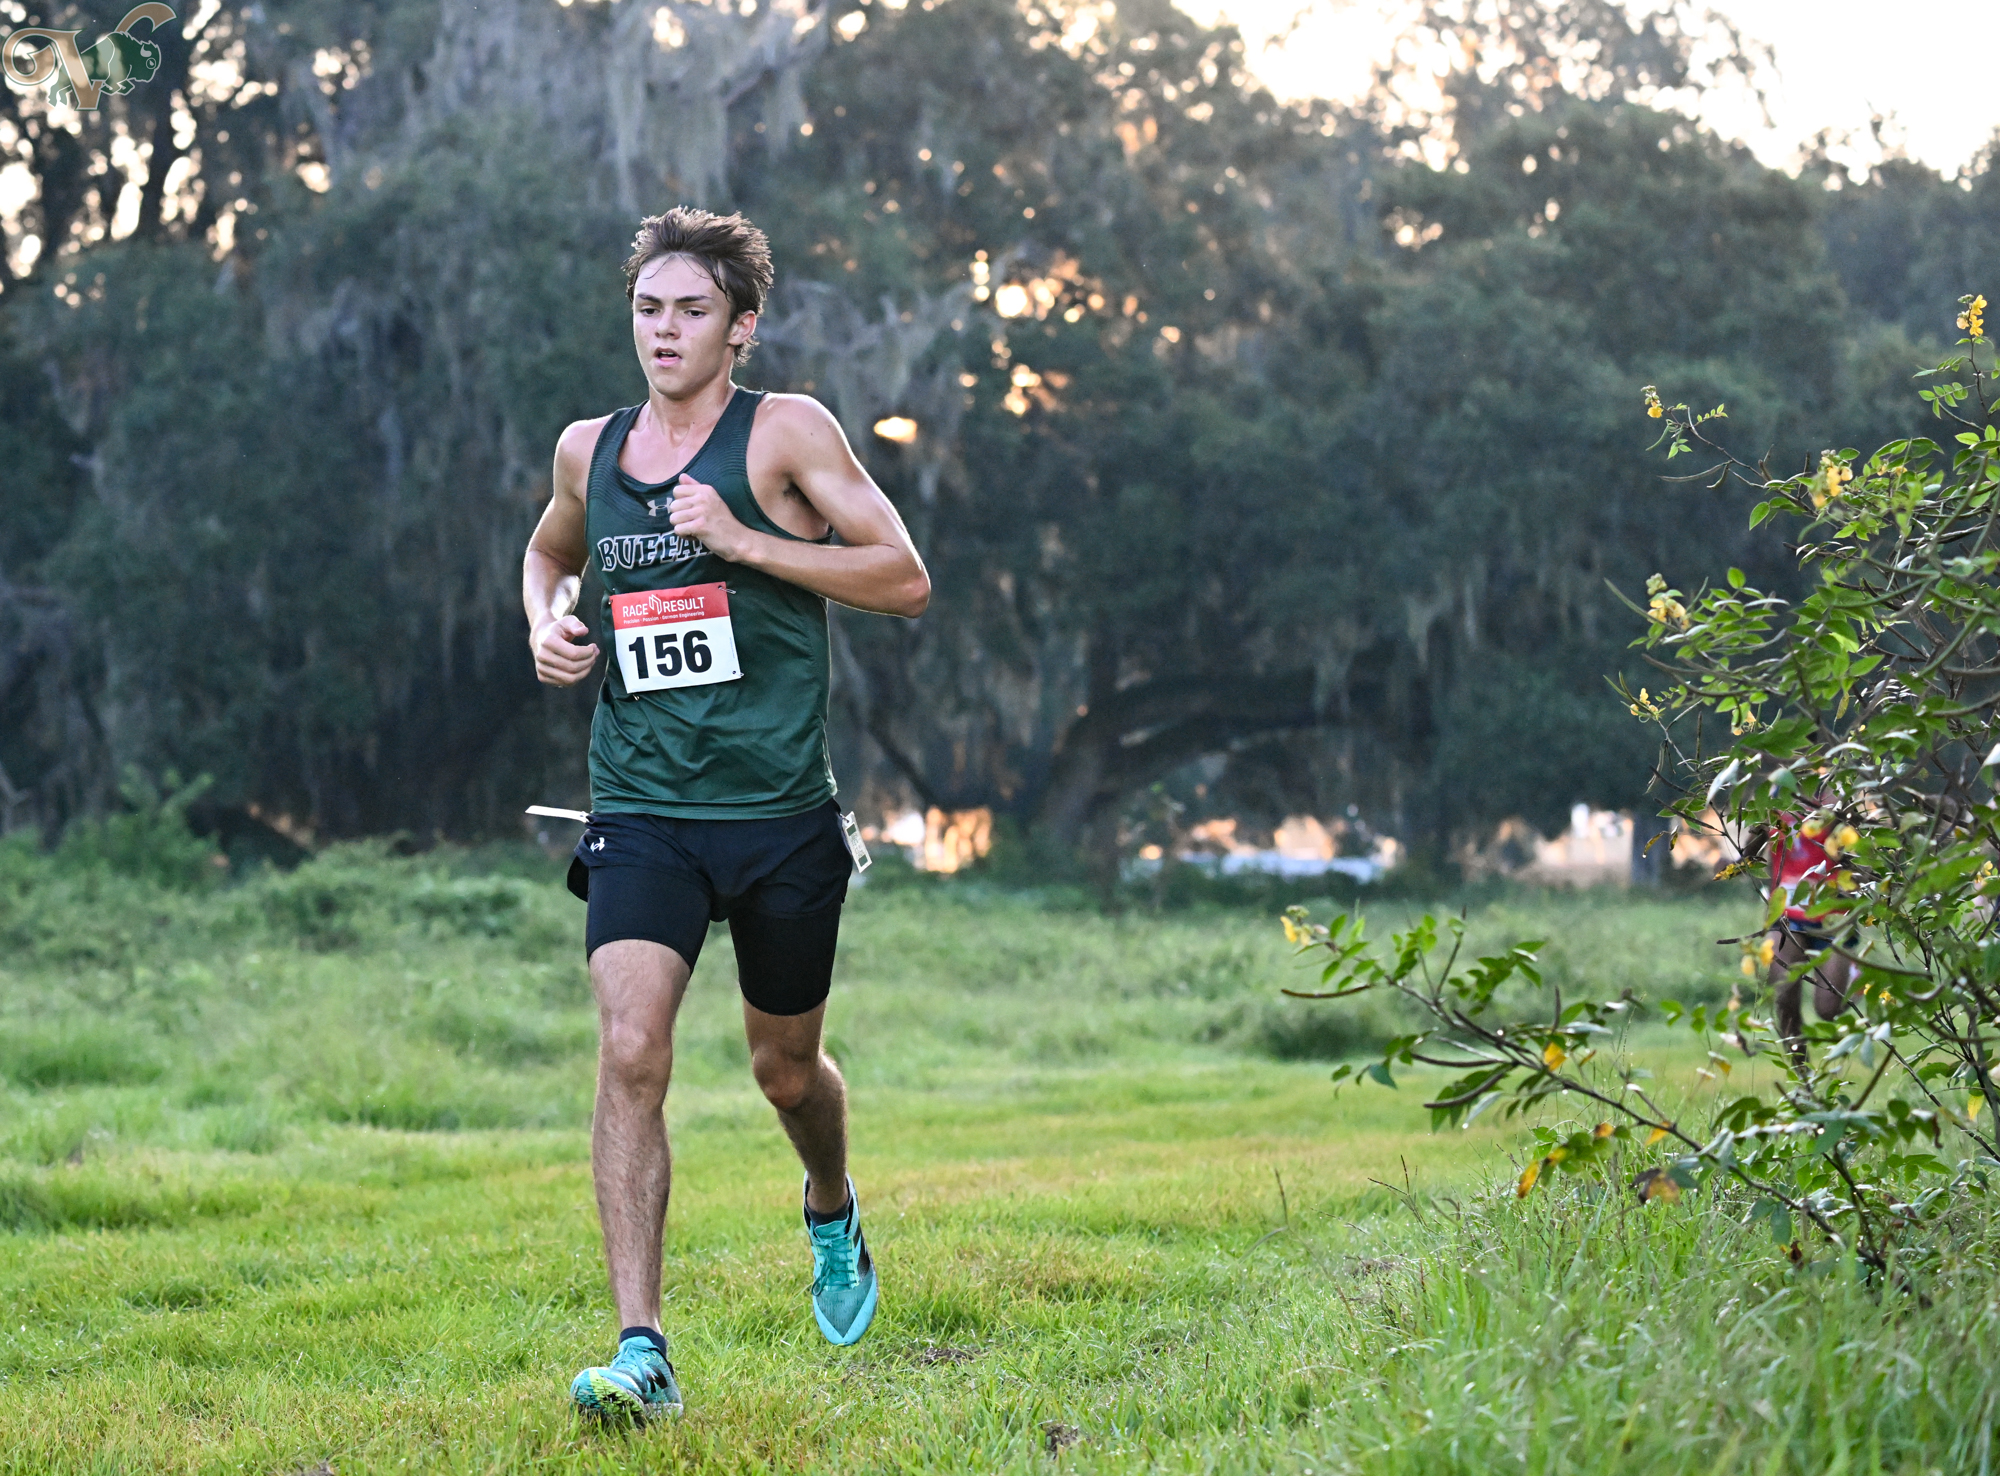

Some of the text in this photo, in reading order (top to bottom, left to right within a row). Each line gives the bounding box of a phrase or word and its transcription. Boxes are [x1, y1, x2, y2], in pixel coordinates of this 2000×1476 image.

[622, 596, 705, 618] RACE RESULT
[628, 630, 713, 680] 156
